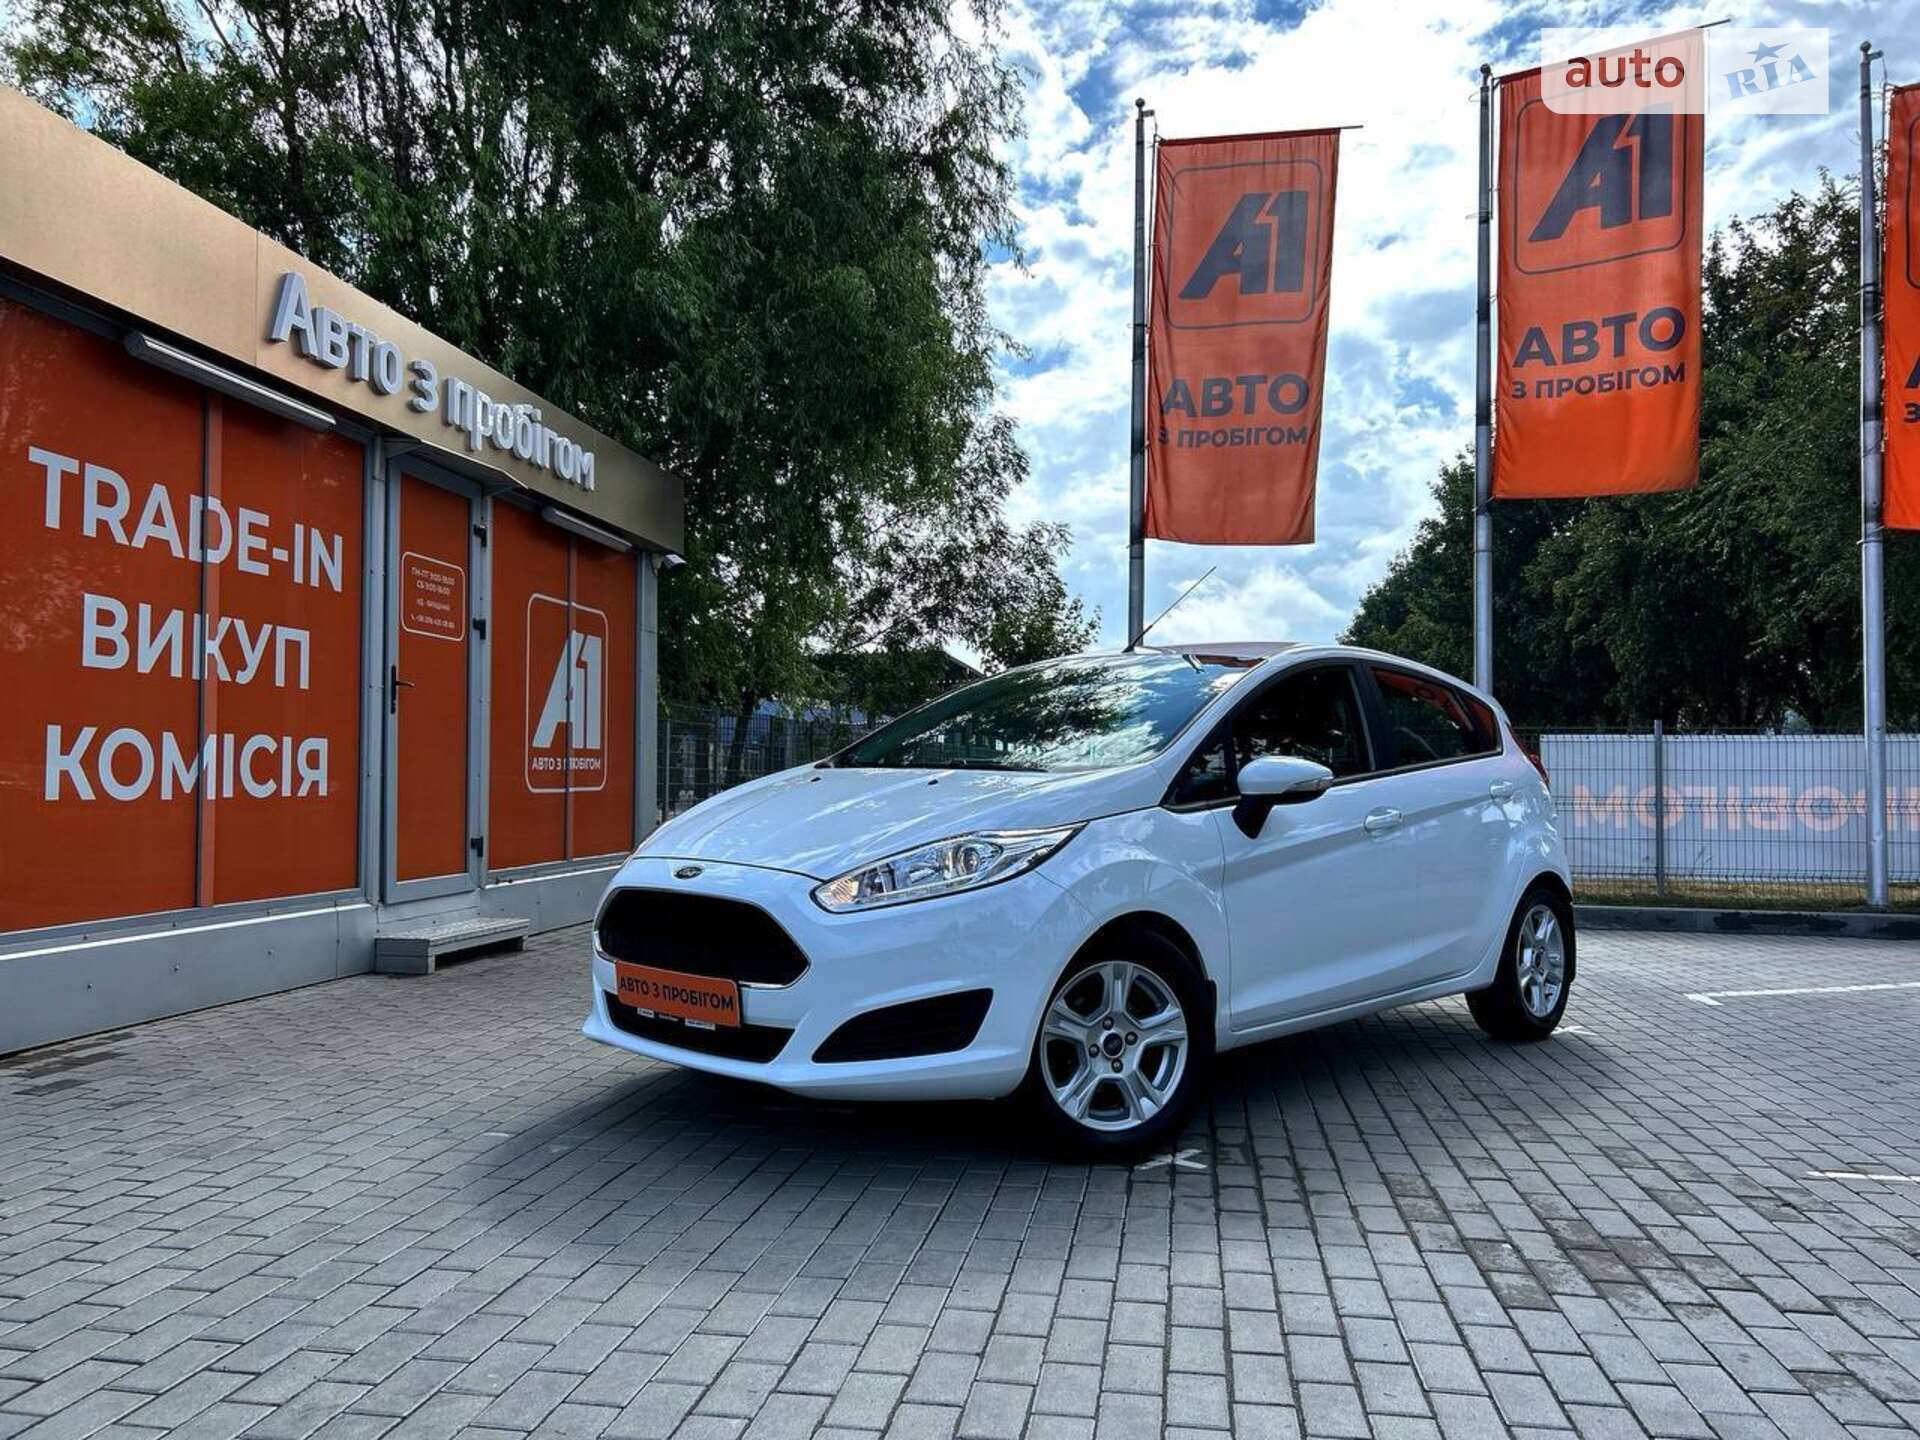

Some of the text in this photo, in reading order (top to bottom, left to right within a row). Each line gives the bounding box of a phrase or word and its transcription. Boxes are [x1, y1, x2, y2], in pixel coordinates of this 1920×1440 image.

[1178, 190, 1310, 300] A1
[1512, 306, 1686, 368] АВТО
[268, 271, 404, 395] Авто
[446, 376, 596, 492] пробігом
[1161, 373, 1311, 418] АВТО
[1535, 362, 1686, 399] ПРОБІГОМ
[1177, 426, 1308, 448] ПРОБІГОМ
[28, 446, 343, 592] TRADE-IN
[82, 592, 311, 690] ВИКУП
[45, 724, 329, 801] КОМІСІЯ
[532, 757, 556, 770] АВТО
[619, 976, 649, 996] АВТО
[662, 985, 735, 1012] ПРОБІГОМ
